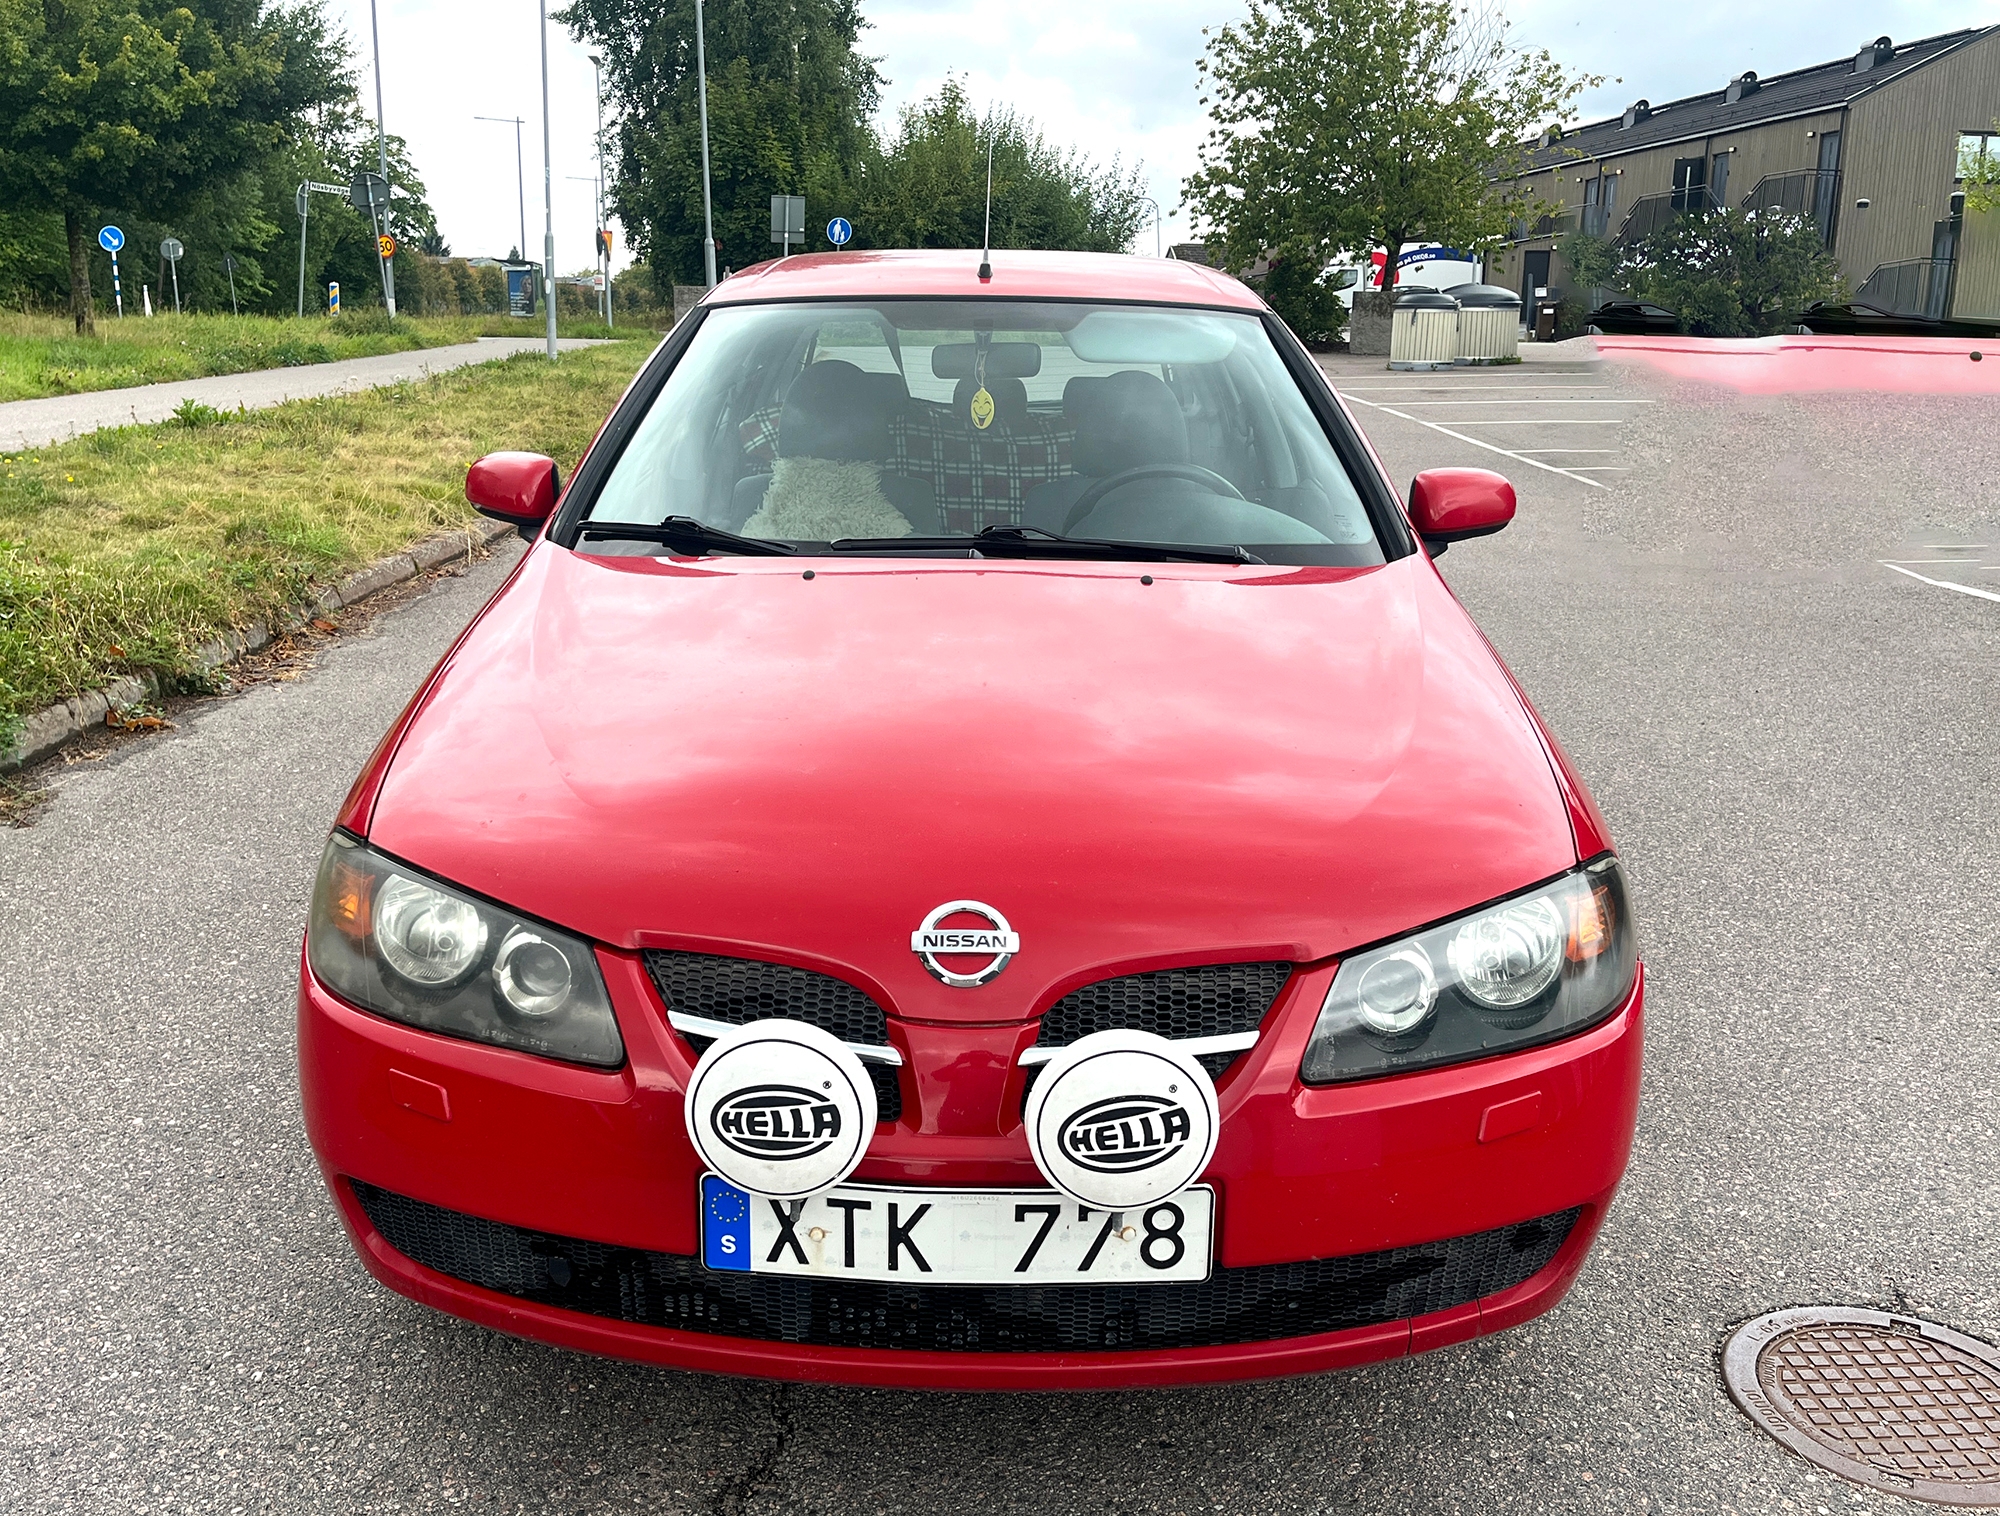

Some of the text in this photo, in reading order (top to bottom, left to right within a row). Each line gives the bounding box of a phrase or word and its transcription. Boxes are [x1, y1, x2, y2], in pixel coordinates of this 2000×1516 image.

[311, 183, 349, 194] Näsbyväge
[379, 240, 392, 252] 50
[1412, 253, 1436, 261] OKQ8.se
[922, 934, 1007, 948] NISSAN
[721, 1103, 842, 1139] HELLA
[1069, 1106, 1191, 1152] HELLA
[720, 1234, 737, 1254] S
[766, 1197, 1185, 1273] XTK 778
[1740, 1387, 1790, 1432] Uponor
